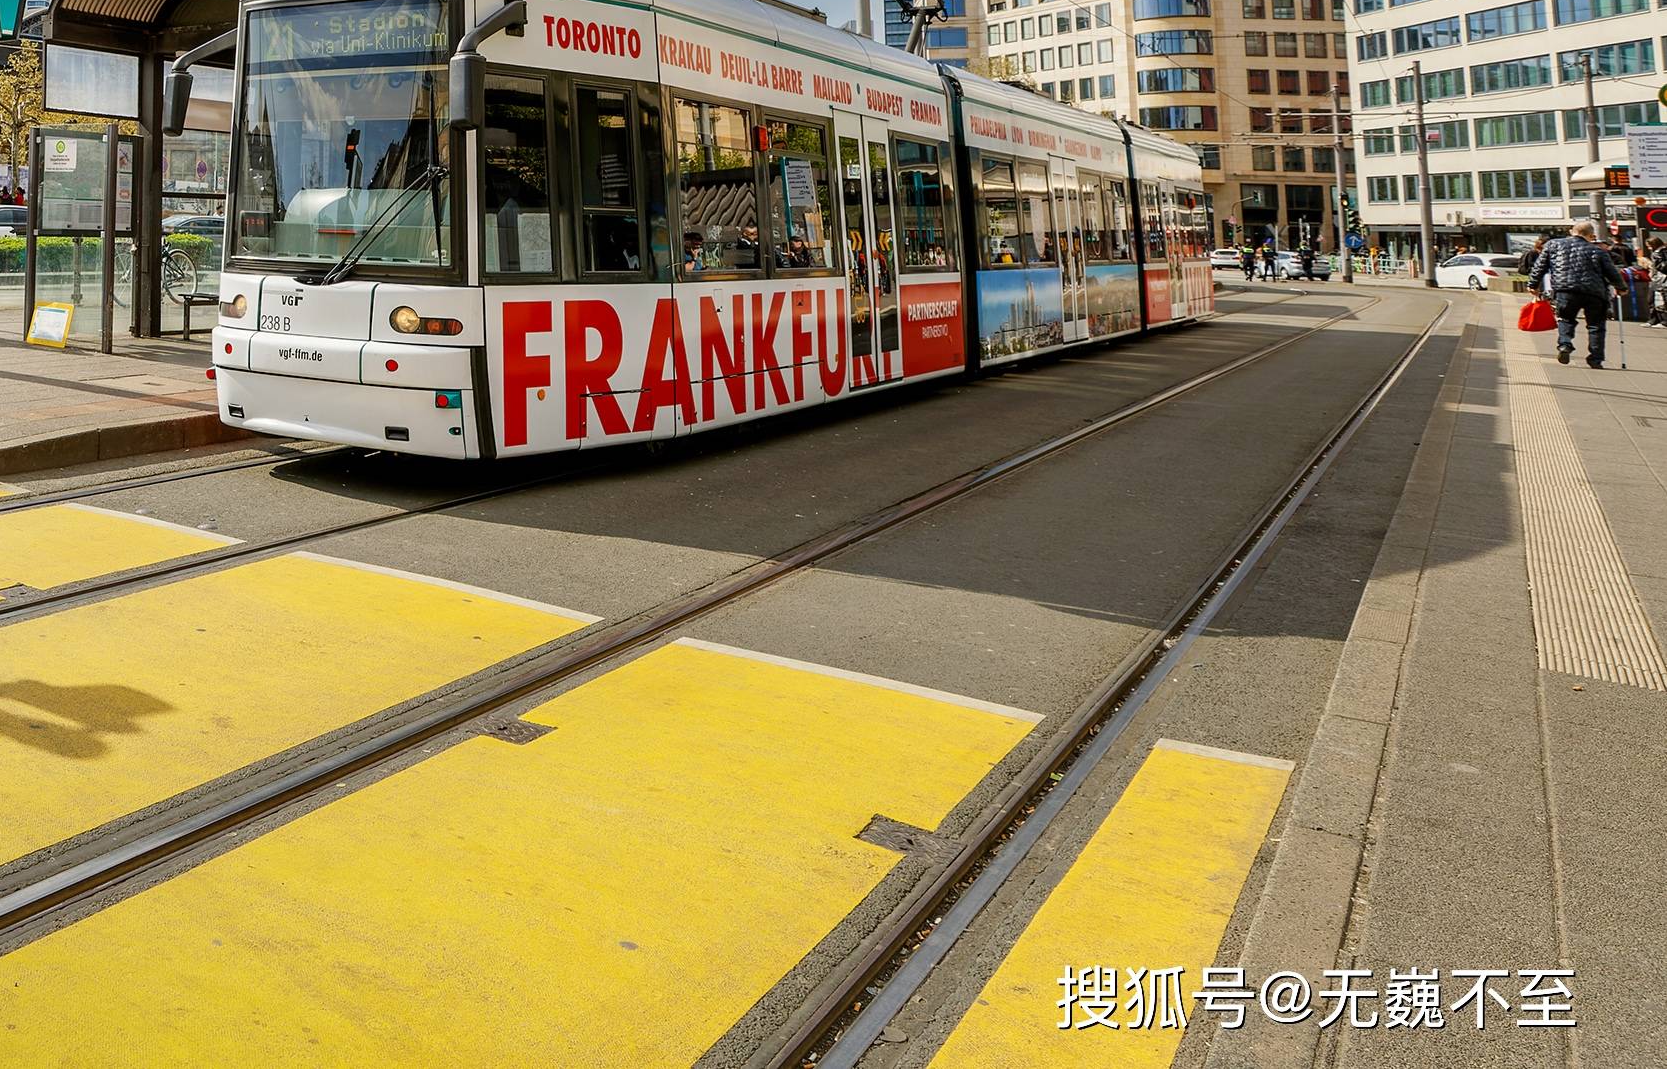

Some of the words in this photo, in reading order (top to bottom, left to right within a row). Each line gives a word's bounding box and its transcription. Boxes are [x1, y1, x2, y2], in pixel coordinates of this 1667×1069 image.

[329, 10, 425, 34] Stadion
[543, 15, 641, 59] TORONTO
[659, 34, 712, 75] KRAKAU
[720, 51, 769, 88] DEUIL-LA
[770, 64, 803, 95] BARRE
[813, 74, 852, 105] MAILAND
[866, 88, 903, 118] BUDAPEST
[910, 100, 942, 127] GRANADA
[908, 300, 958, 321] PARTNERSCHAFT
[261, 315, 280, 330] 238
[283, 317, 291, 331] B
[279, 348, 323, 361] vgf-ffm.de
[503, 285, 894, 447] FRANKFU
